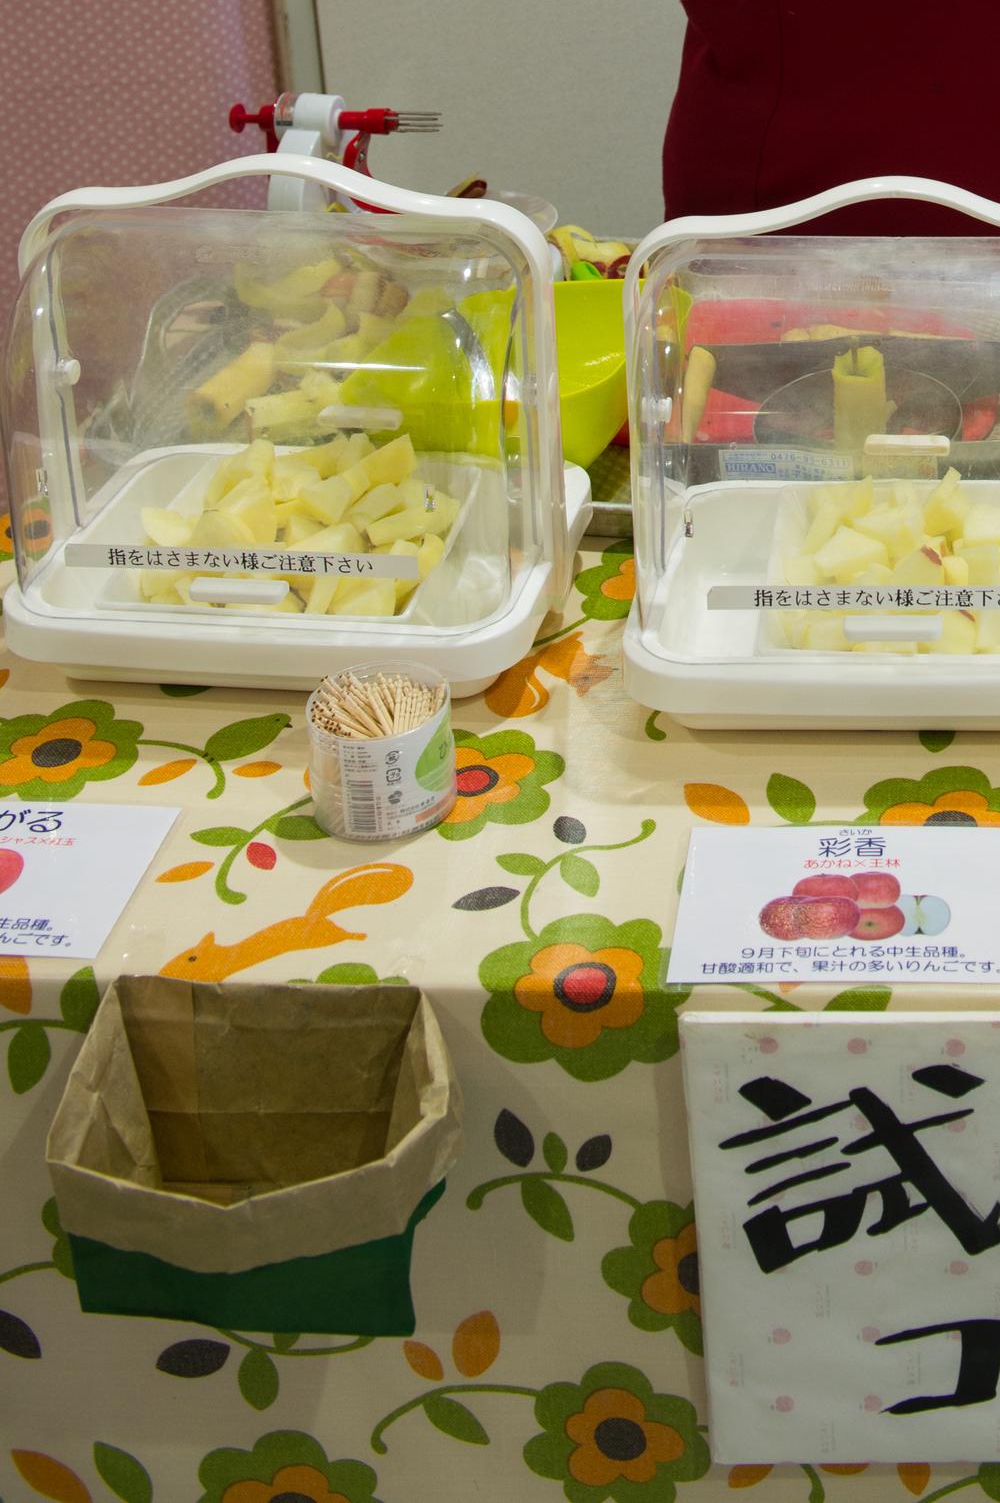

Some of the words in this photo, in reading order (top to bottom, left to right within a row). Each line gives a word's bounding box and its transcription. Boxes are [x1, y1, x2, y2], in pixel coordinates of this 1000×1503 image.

[726, 463, 775, 473] HIRANO
[107, 547, 374, 574] 指をはさまない様ご注意下さい
[838, 828, 873, 836] さいか
[818, 837, 887, 858] 彩香
[803, 858, 901, 868] あかね×王林
[741, 946, 968, 960] 9月下旬にとれる中生品種。
